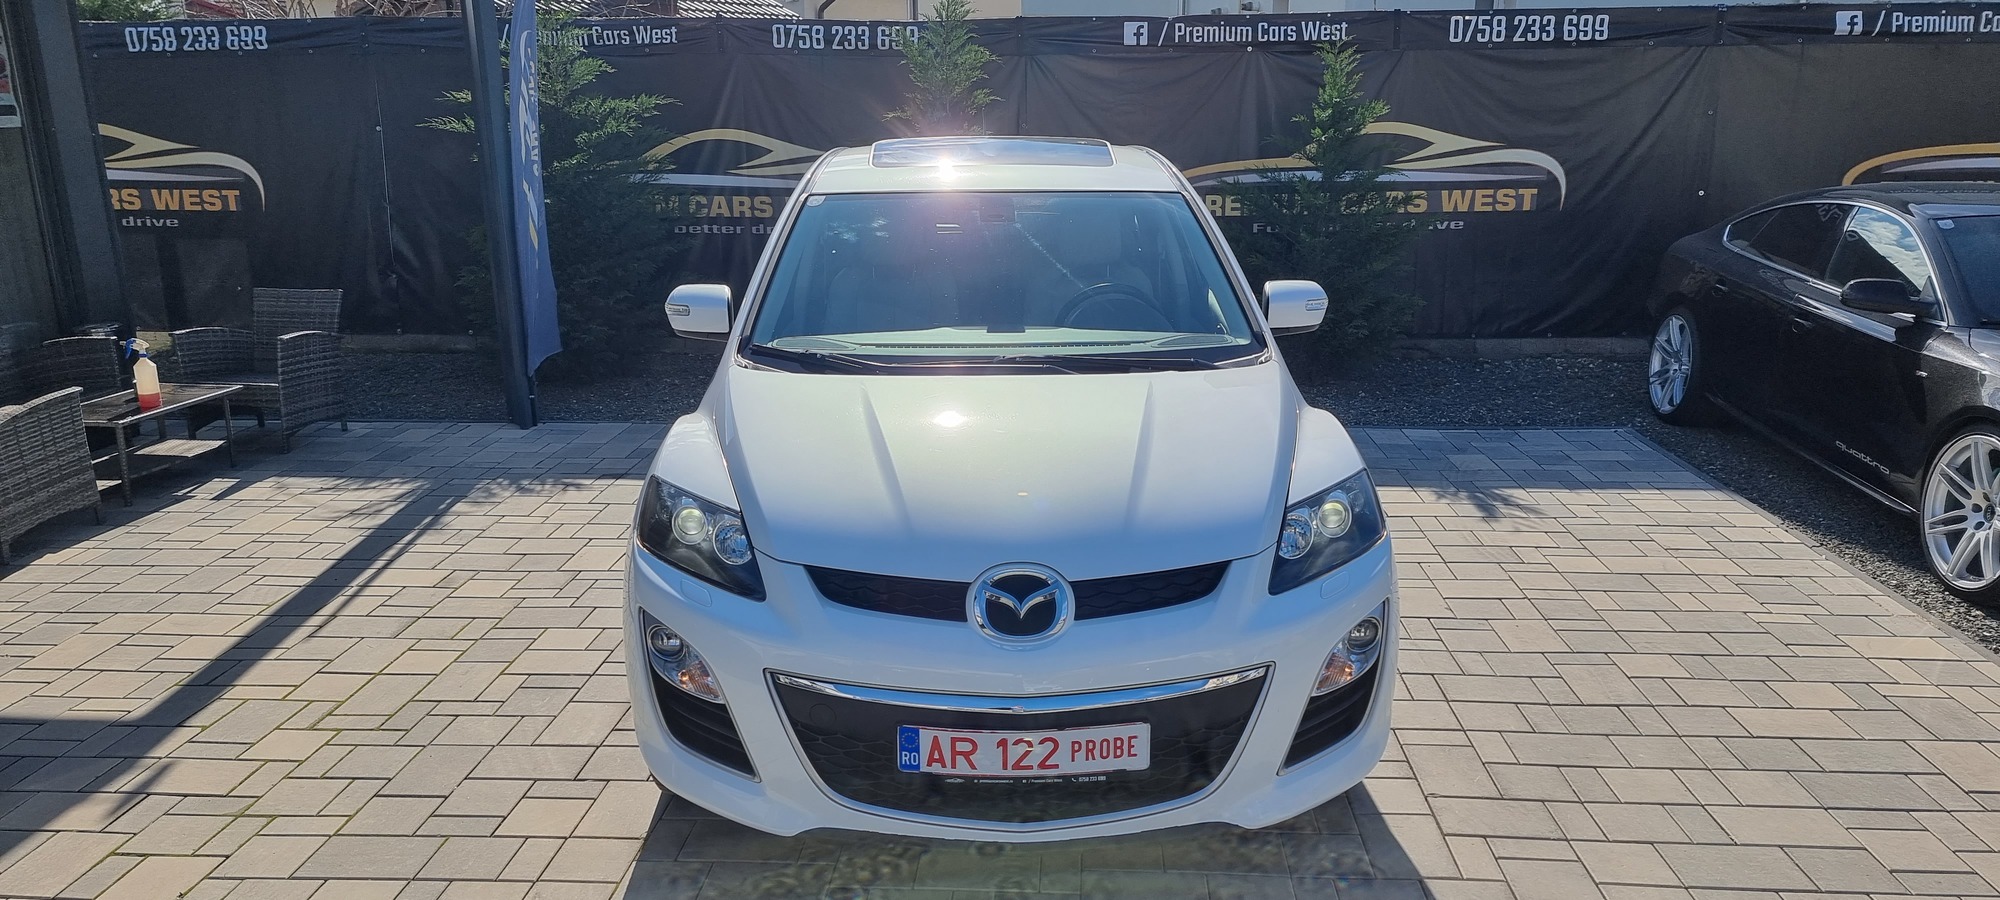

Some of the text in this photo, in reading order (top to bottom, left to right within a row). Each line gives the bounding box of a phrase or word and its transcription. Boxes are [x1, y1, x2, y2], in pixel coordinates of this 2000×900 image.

[1174, 21, 1252, 43] Premium
[1257, 22, 1297, 42] Cars
[1301, 21, 1348, 41] West
[1449, 14, 1610, 43] 0758 233 699
[1892, 10, 1975, 33] Premium
[124, 25, 269, 53] 0758 233 699
[592, 26, 630, 46] Cars
[633, 25, 678, 45] West
[771, 24, 825, 49] 0758
[832, 24, 870, 50] 233
[109, 188, 240, 212] RS WEST
[688, 195, 774, 218] CARS
[1441, 188, 1538, 213] WEST
[122, 216, 179, 227] drive
[1835, 440, 1890, 475] quattro
[902, 752, 919, 765] RO
[926, 735, 1138, 771] AR 122 PROBE
